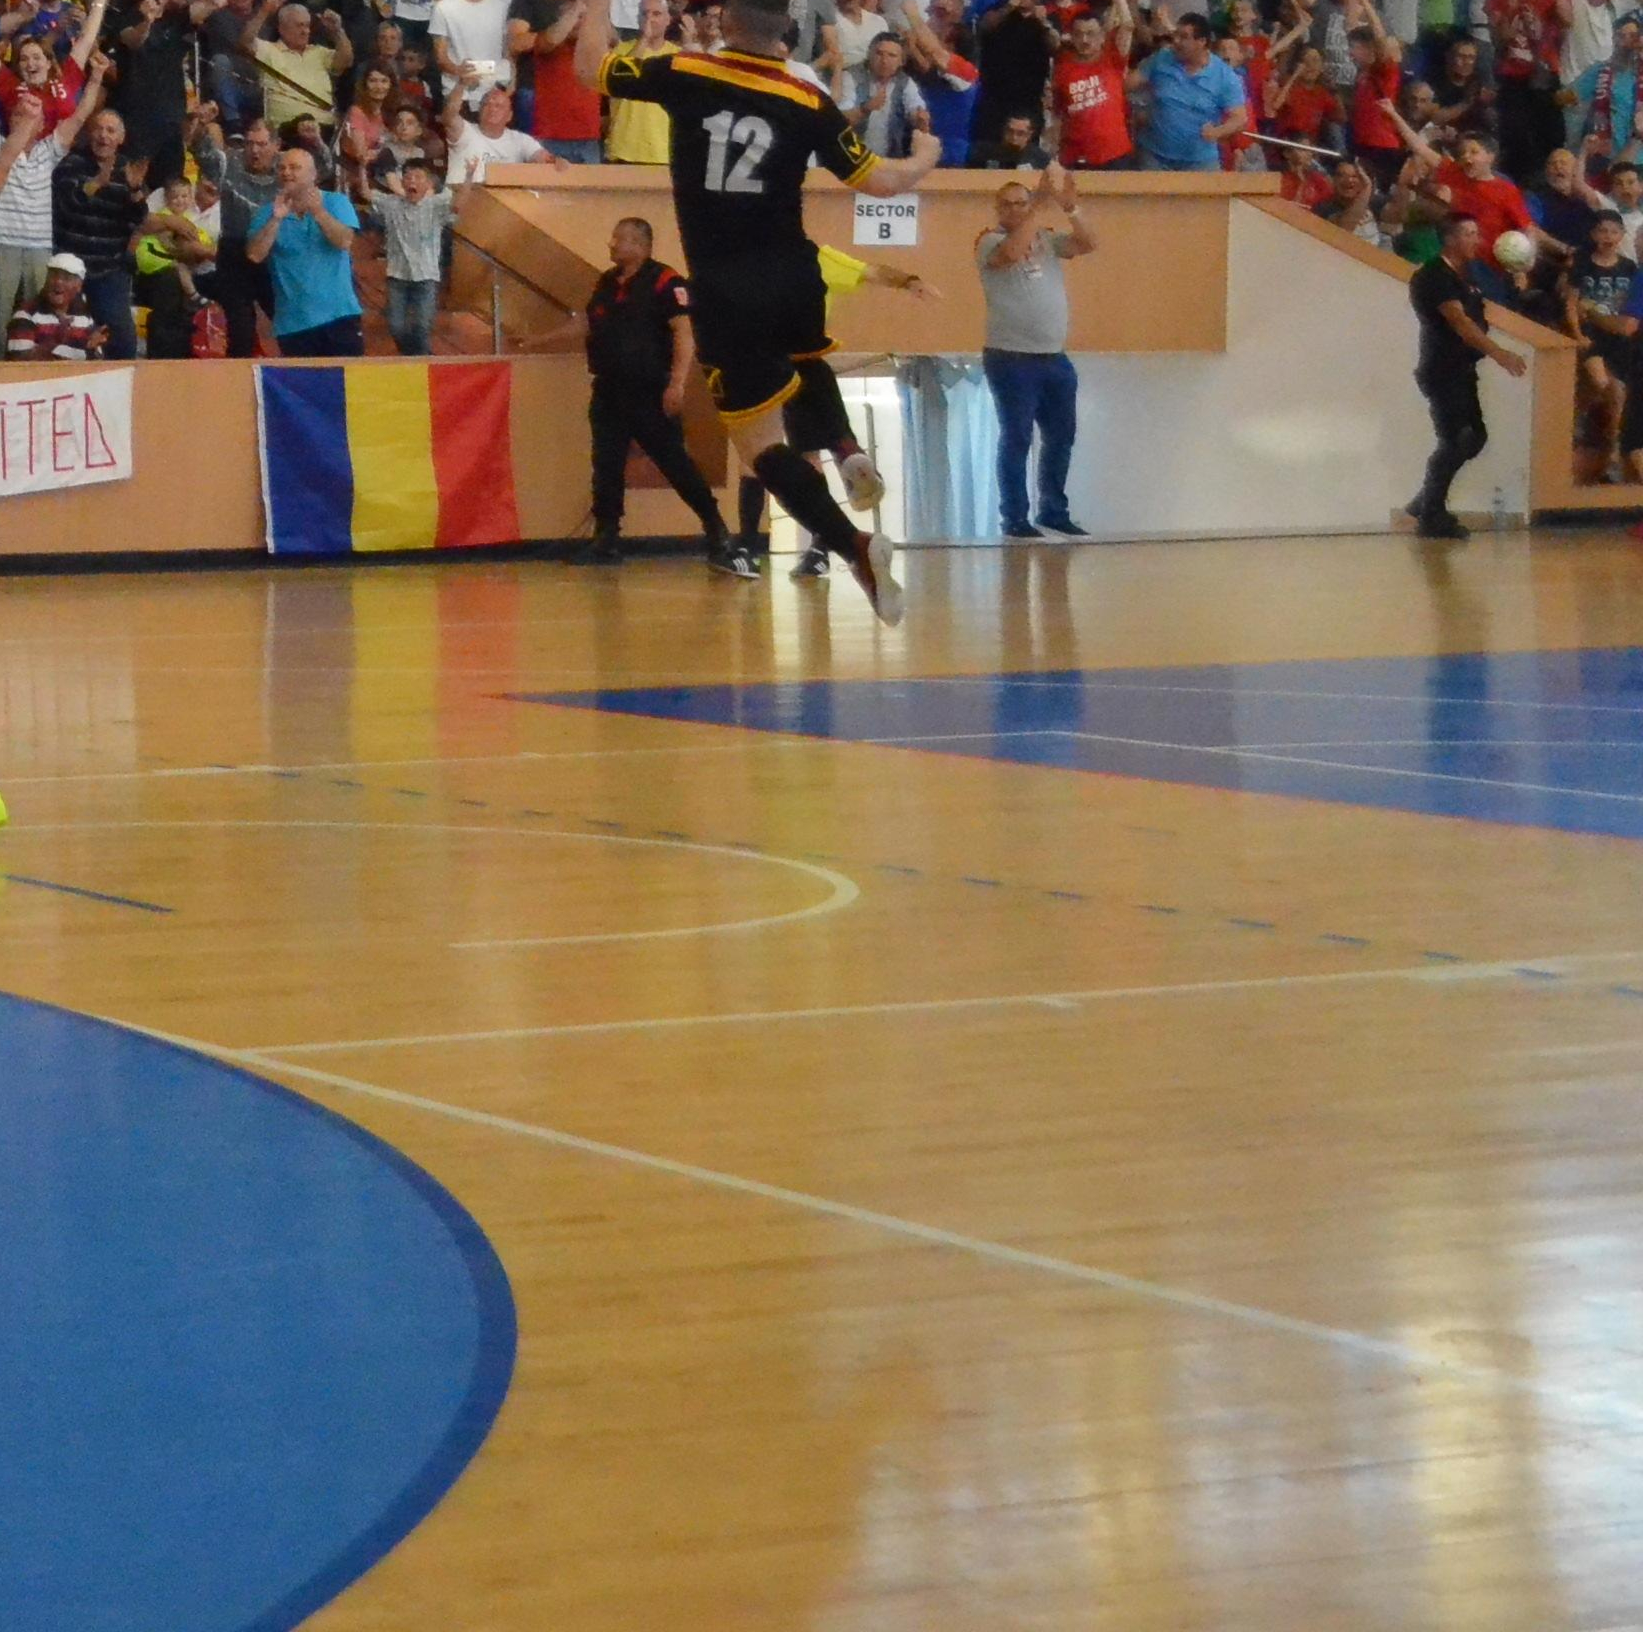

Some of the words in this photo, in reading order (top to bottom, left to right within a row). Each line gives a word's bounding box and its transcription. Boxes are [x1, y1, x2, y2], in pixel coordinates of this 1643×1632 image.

[702, 109, 773, 194] 12
[856, 204, 916, 217] SECTOR
[878, 222, 891, 239] B
